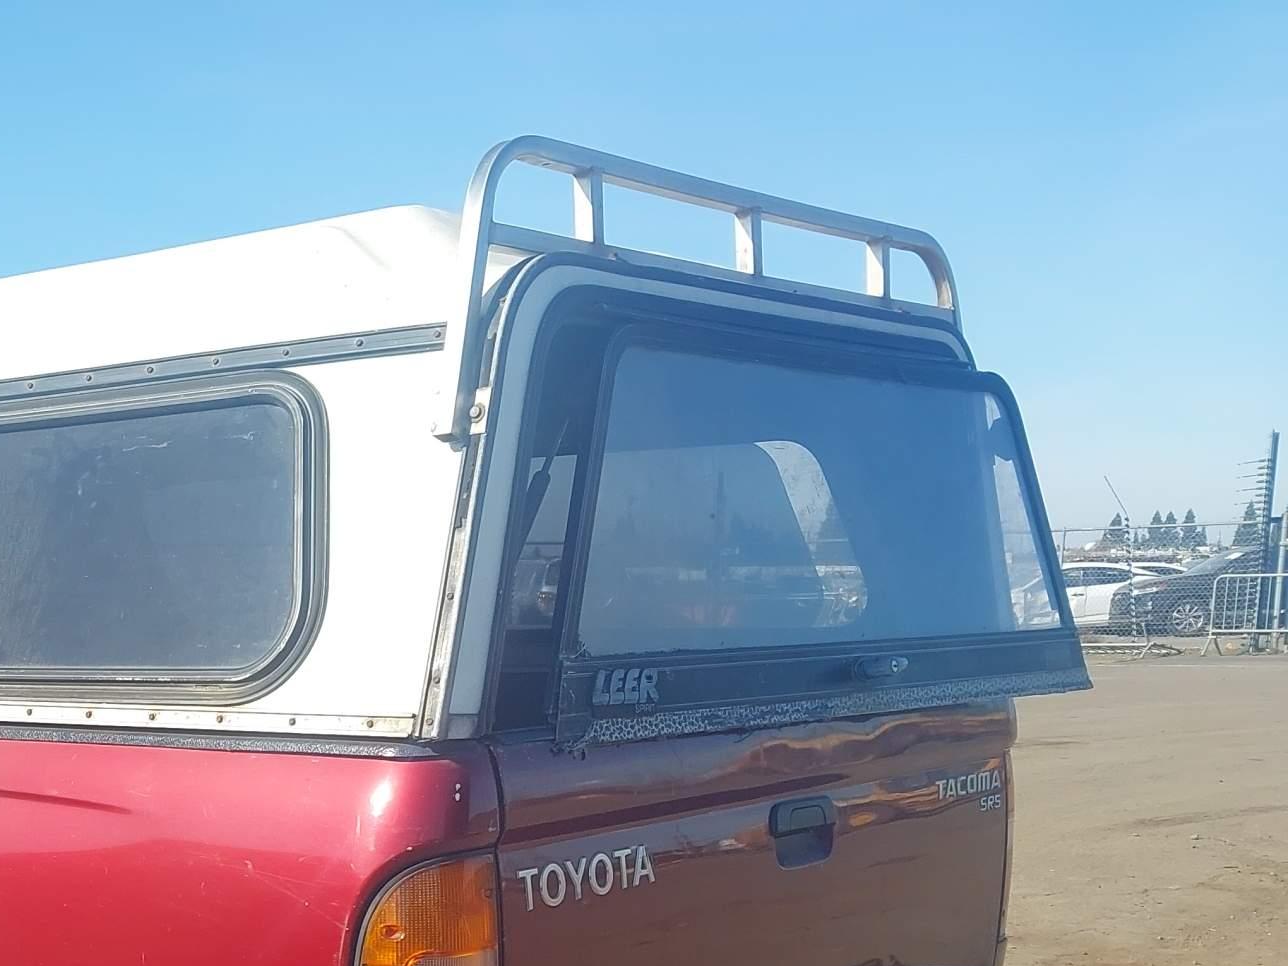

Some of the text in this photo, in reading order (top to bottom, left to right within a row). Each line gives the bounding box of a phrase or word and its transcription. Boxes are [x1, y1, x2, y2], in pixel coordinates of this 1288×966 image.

[592, 668, 659, 706] LEER
[935, 770, 1001, 800] TACOMA
[979, 795, 1002, 812] SR5
[516, 844, 656, 912] TOYOTA
